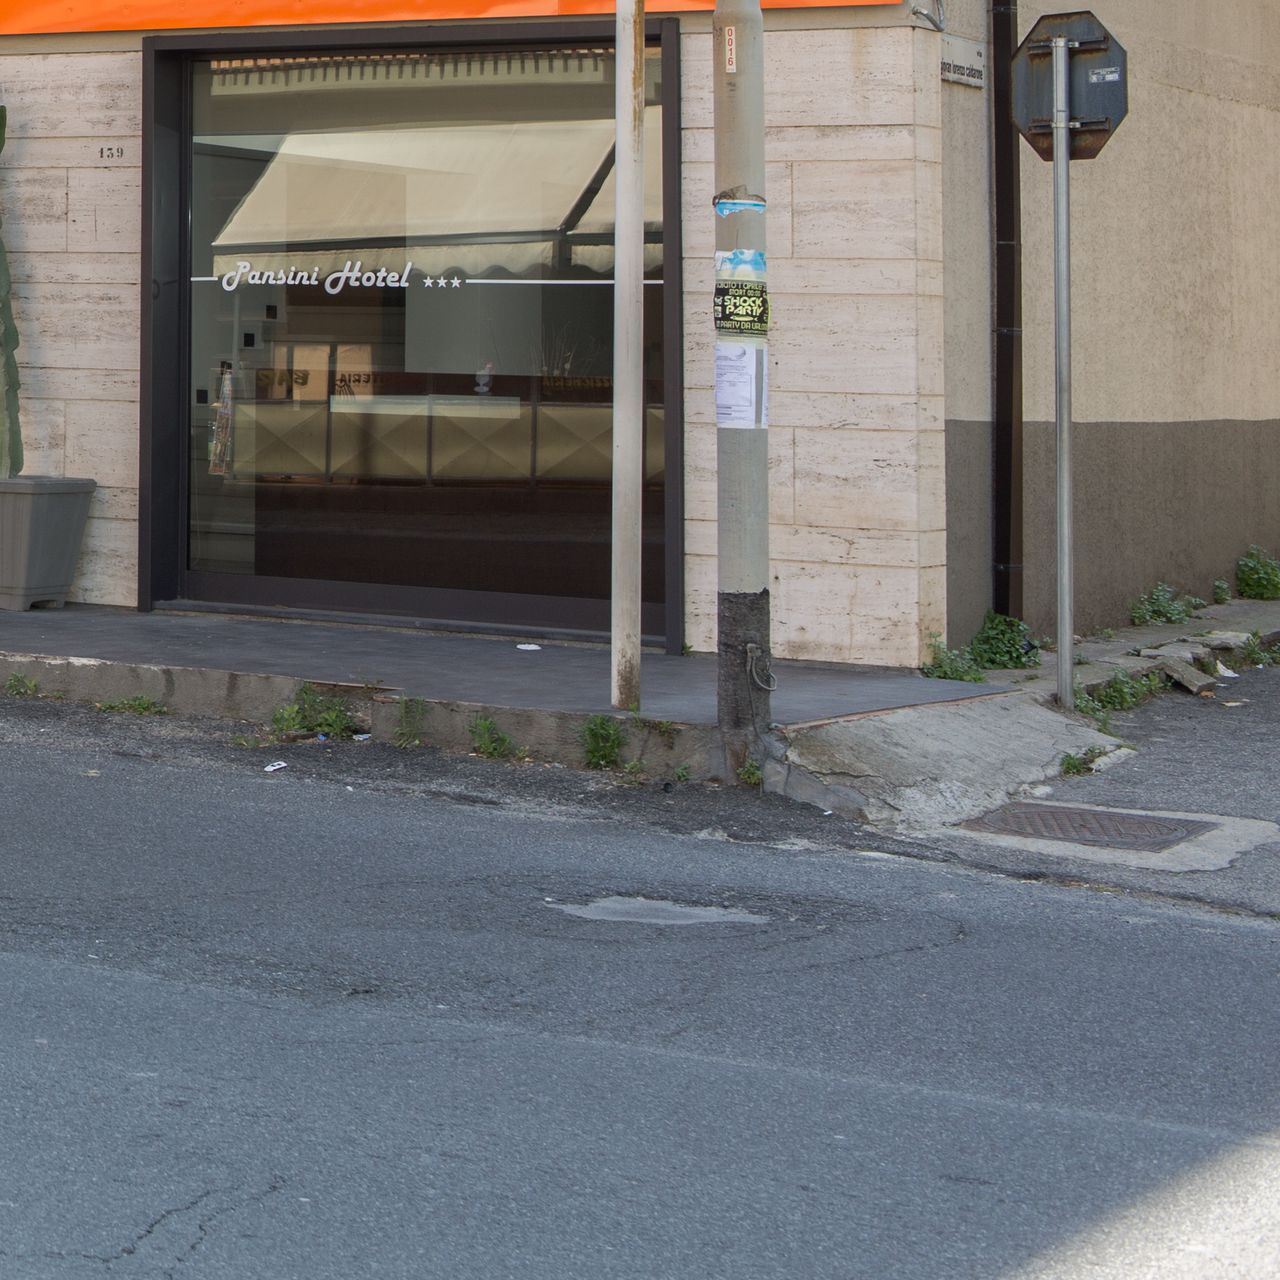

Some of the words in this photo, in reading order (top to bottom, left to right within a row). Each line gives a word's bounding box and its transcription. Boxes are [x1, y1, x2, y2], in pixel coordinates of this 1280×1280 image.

[98, 146, 124, 160] 139
[221, 261, 319, 292] Pansini
[324, 260, 413, 295] Hotel
[723, 295, 763, 307] SHOCK
[725, 305, 764, 316] PARTY
[720, 320, 740, 329] PARTY
